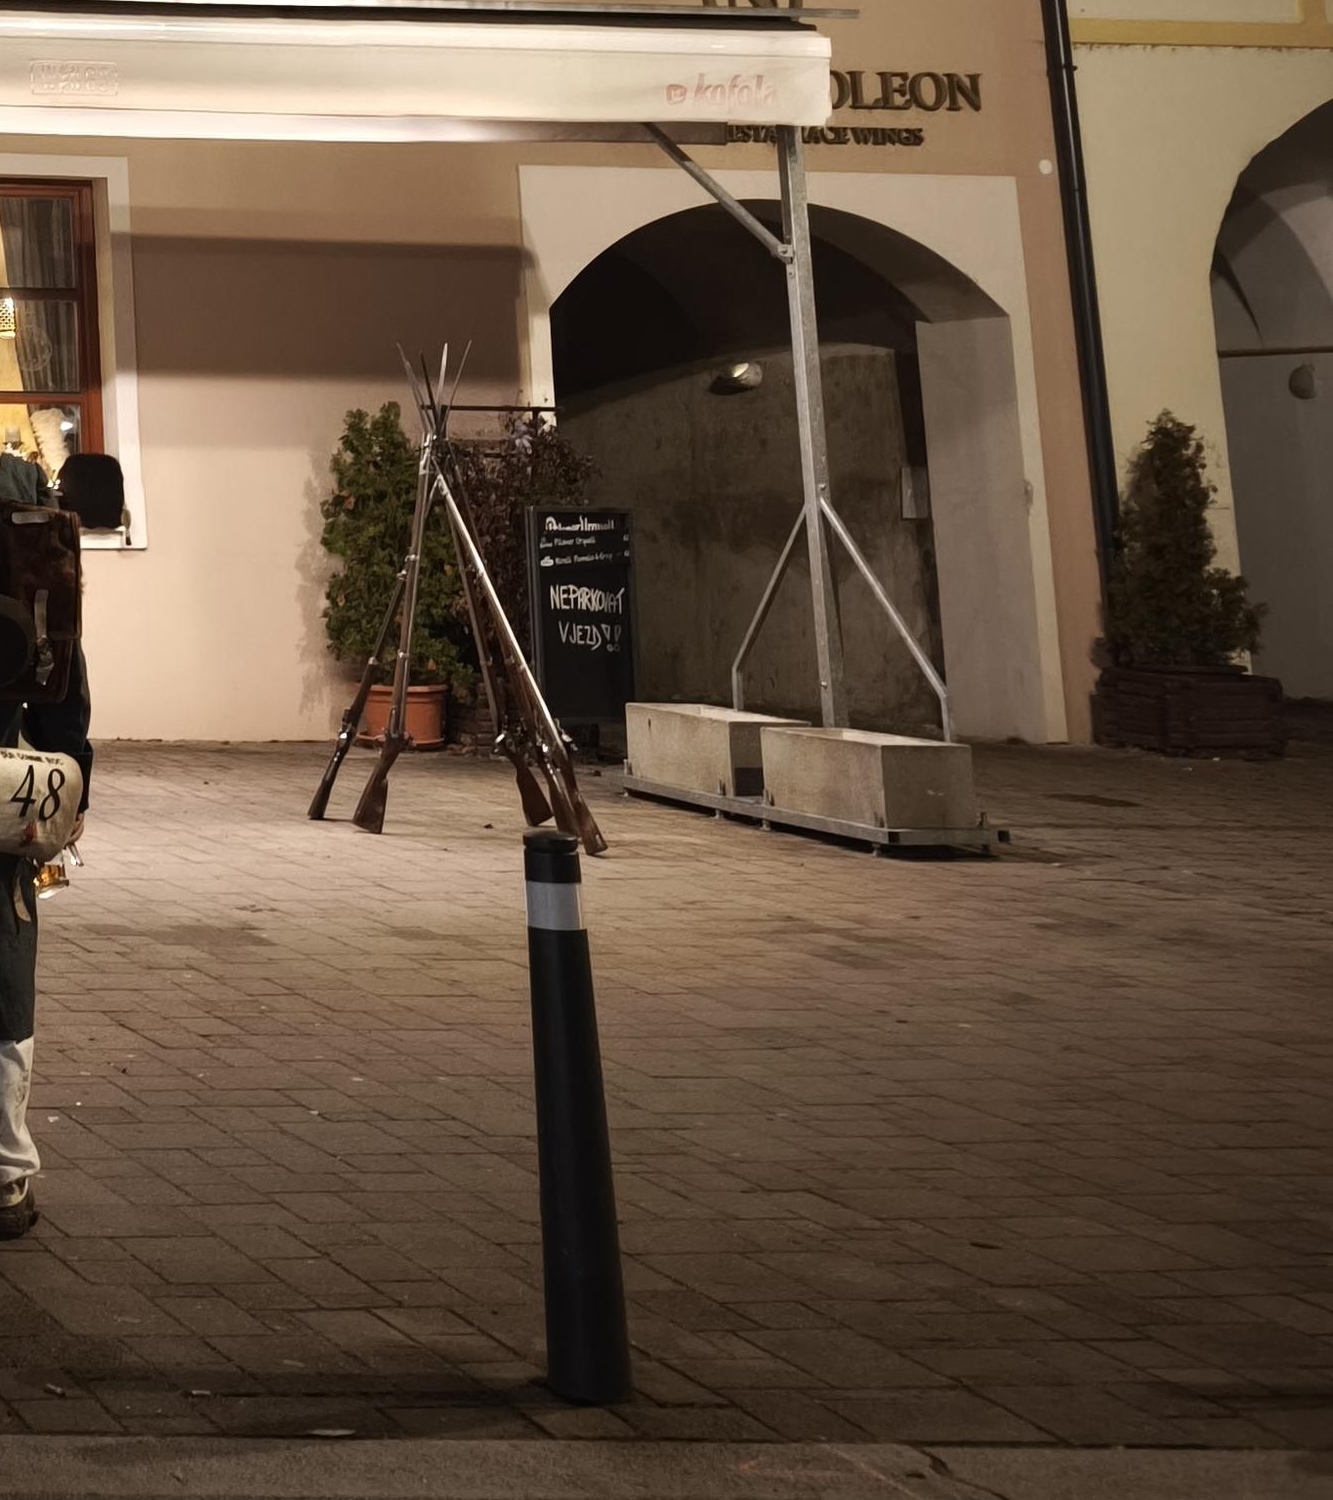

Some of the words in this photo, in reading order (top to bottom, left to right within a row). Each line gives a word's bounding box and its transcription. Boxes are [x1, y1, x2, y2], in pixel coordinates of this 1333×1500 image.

[830, 69, 983, 112] OLEON
[850, 127, 925, 147] WINGS
[9, 764, 66, 822] 48
